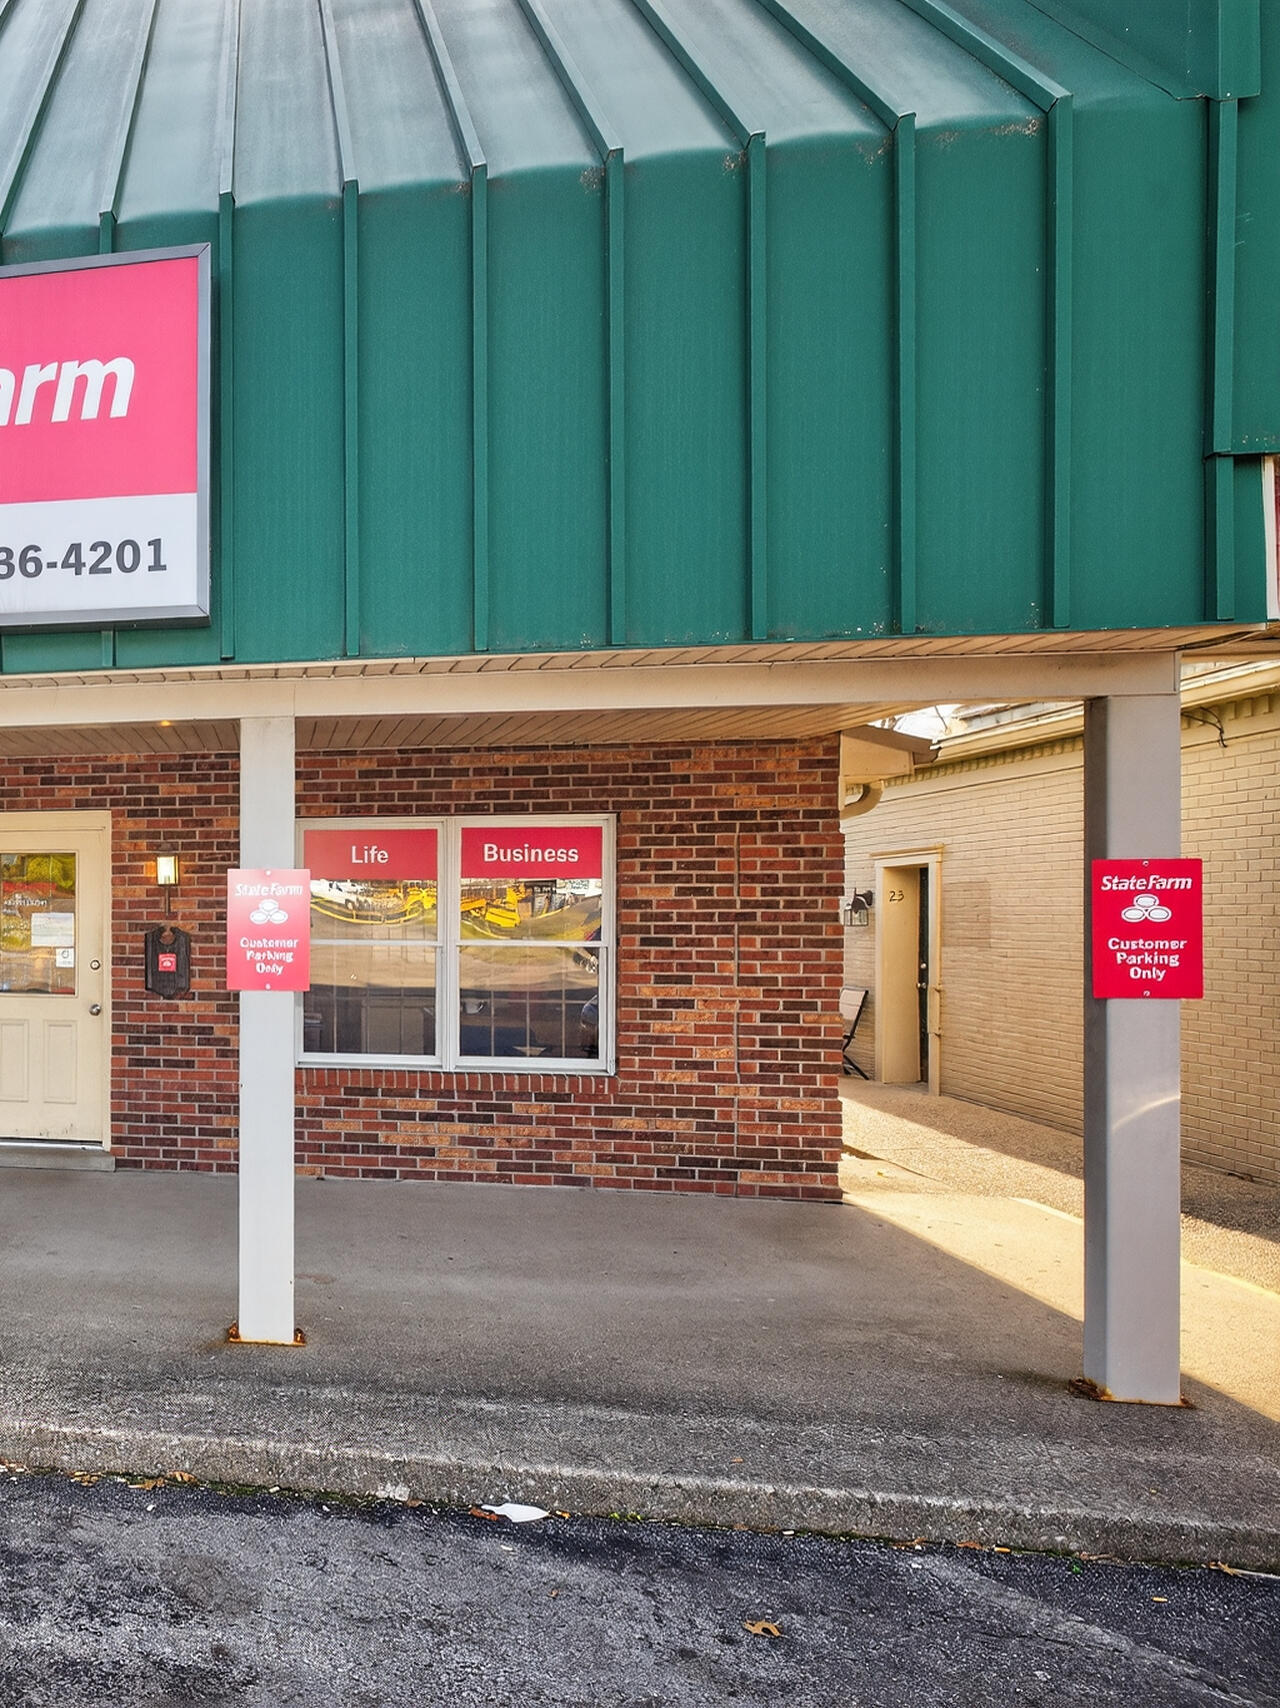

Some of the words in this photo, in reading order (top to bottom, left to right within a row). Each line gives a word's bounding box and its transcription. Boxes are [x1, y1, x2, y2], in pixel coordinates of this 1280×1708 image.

[351, 845, 389, 864] Life
[483, 843, 579, 863] Business
[889, 890, 905, 902] 23
[240, 937, 299, 948] Customer
[1108, 937, 1187, 950] Customer
[246, 950, 294, 963] Parking
[1116, 952, 1180, 967] Parking
[255, 962, 284, 975] Only
[1129, 966, 1166, 981] Only
